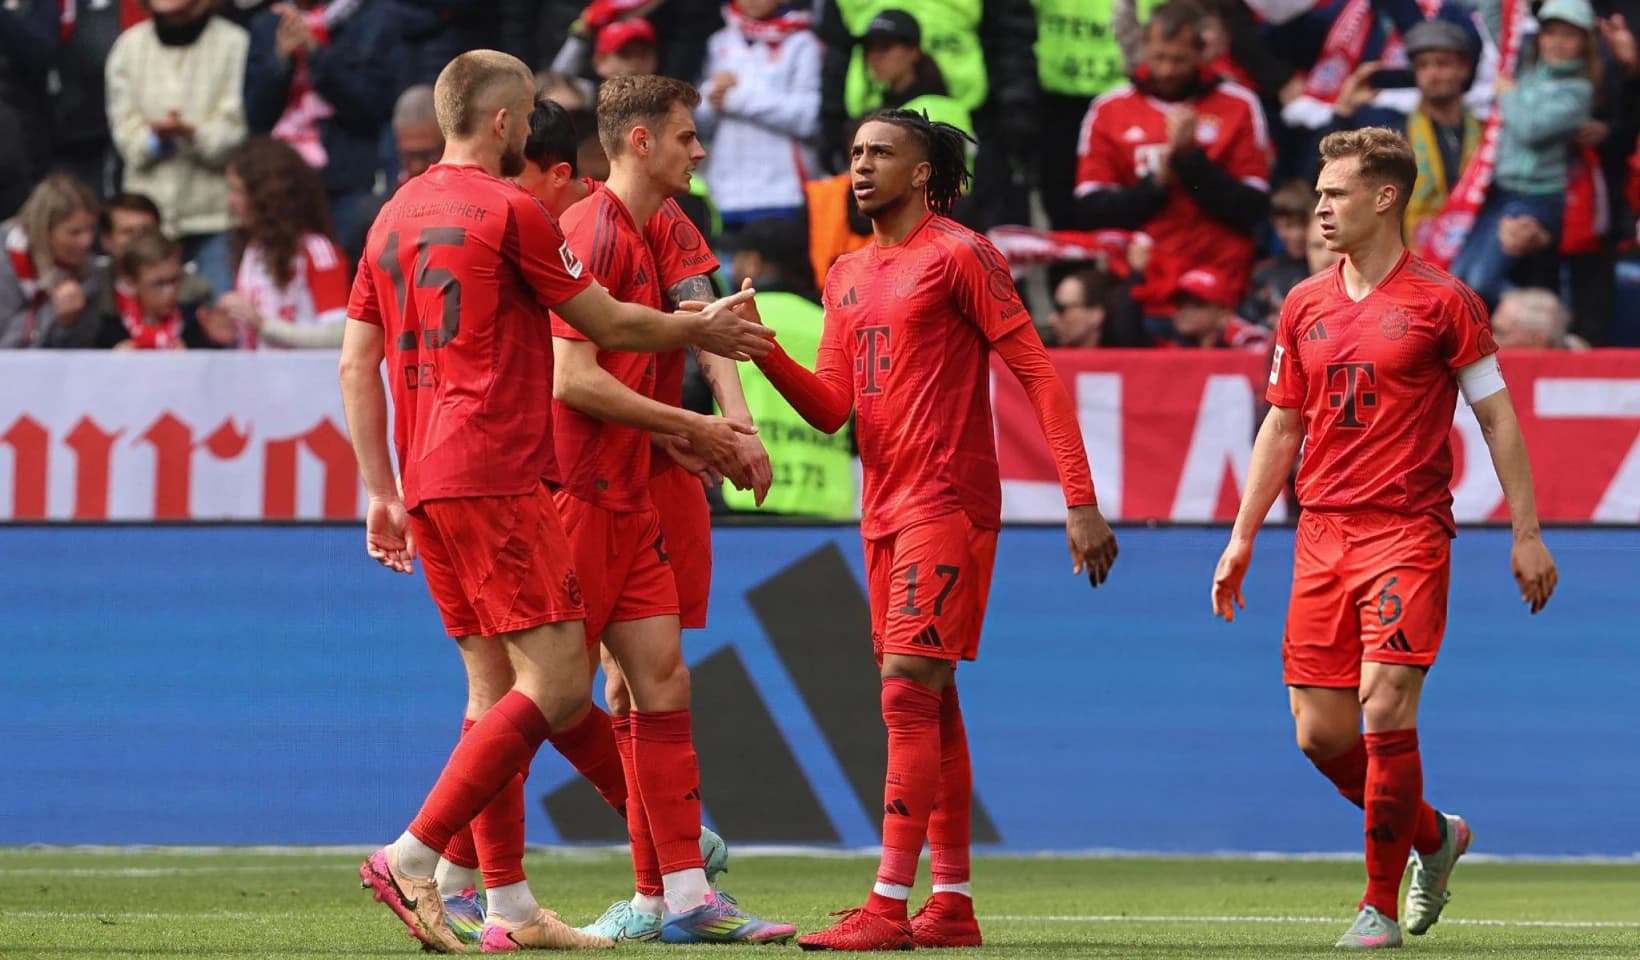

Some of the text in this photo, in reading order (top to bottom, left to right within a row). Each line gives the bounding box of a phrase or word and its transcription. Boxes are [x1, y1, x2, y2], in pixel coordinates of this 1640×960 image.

[377, 227, 466, 352] 15
[1326, 362, 1376, 428] T
[899, 563, 960, 617] 17
[1378, 575, 1402, 625] 6
